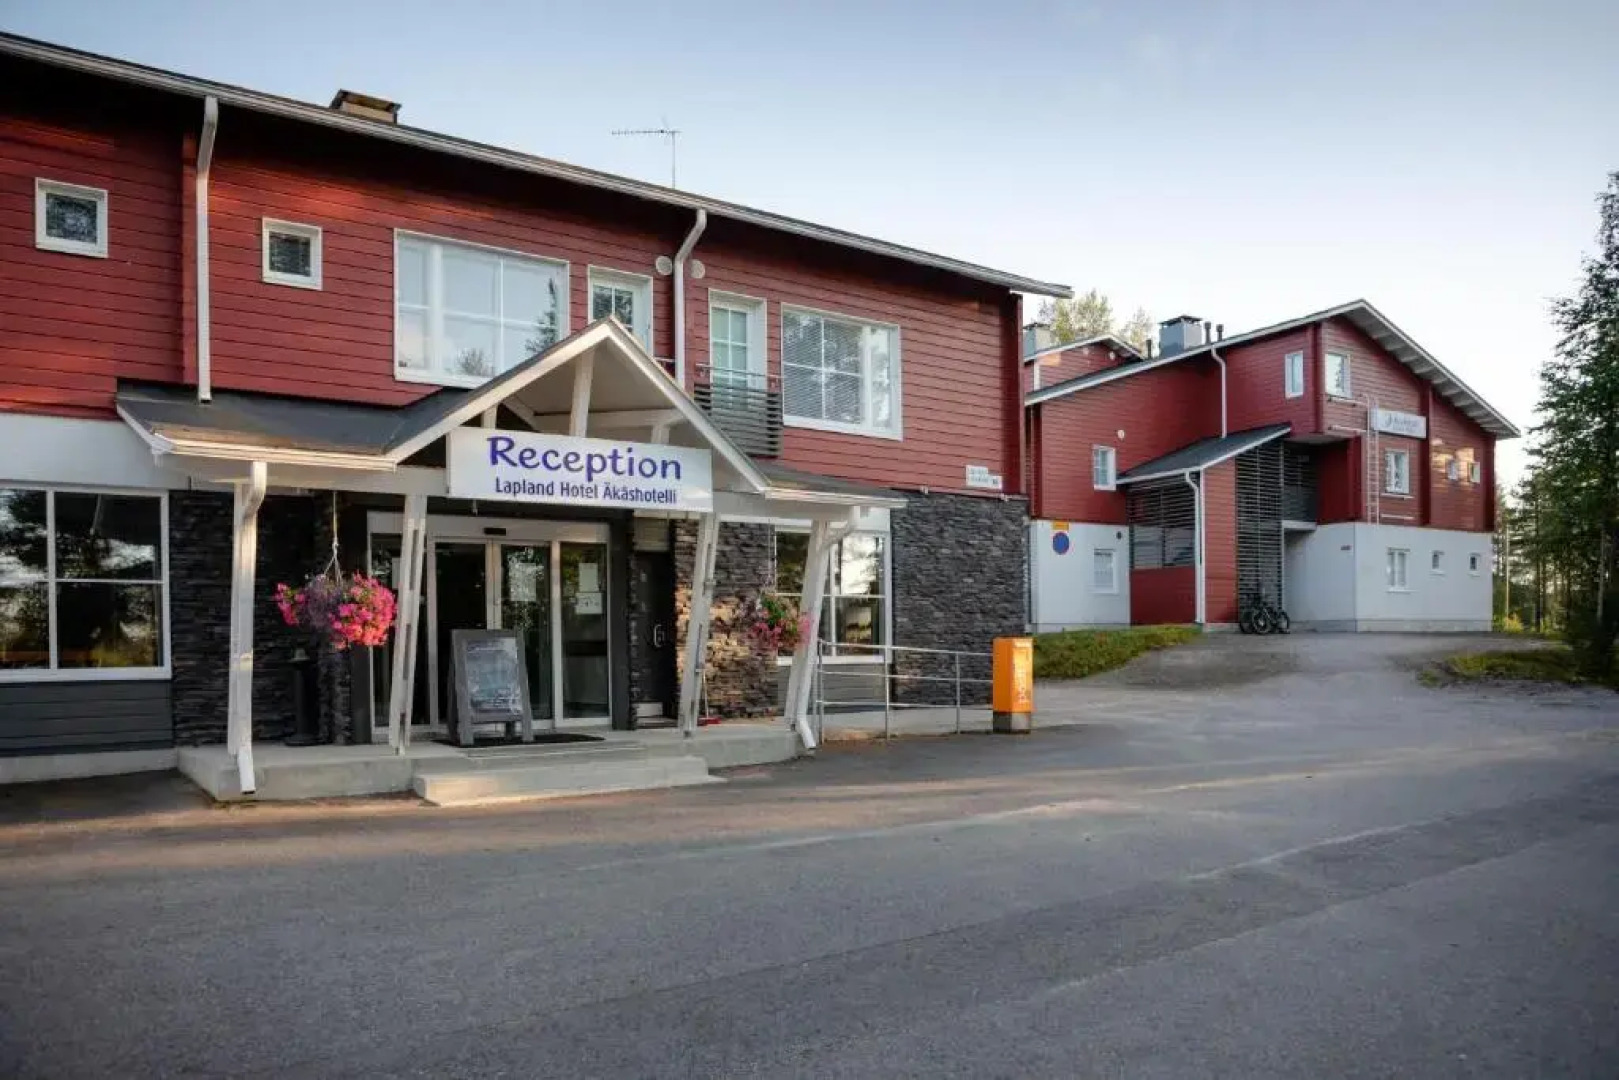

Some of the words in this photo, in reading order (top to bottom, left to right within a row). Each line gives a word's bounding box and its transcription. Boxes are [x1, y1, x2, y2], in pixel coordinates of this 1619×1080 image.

[488, 436, 681, 481] Reception
[495, 477, 554, 497] Lapland
[560, 481, 598, 499] Hotel
[603, 482, 677, 504] Äkäshotelli
